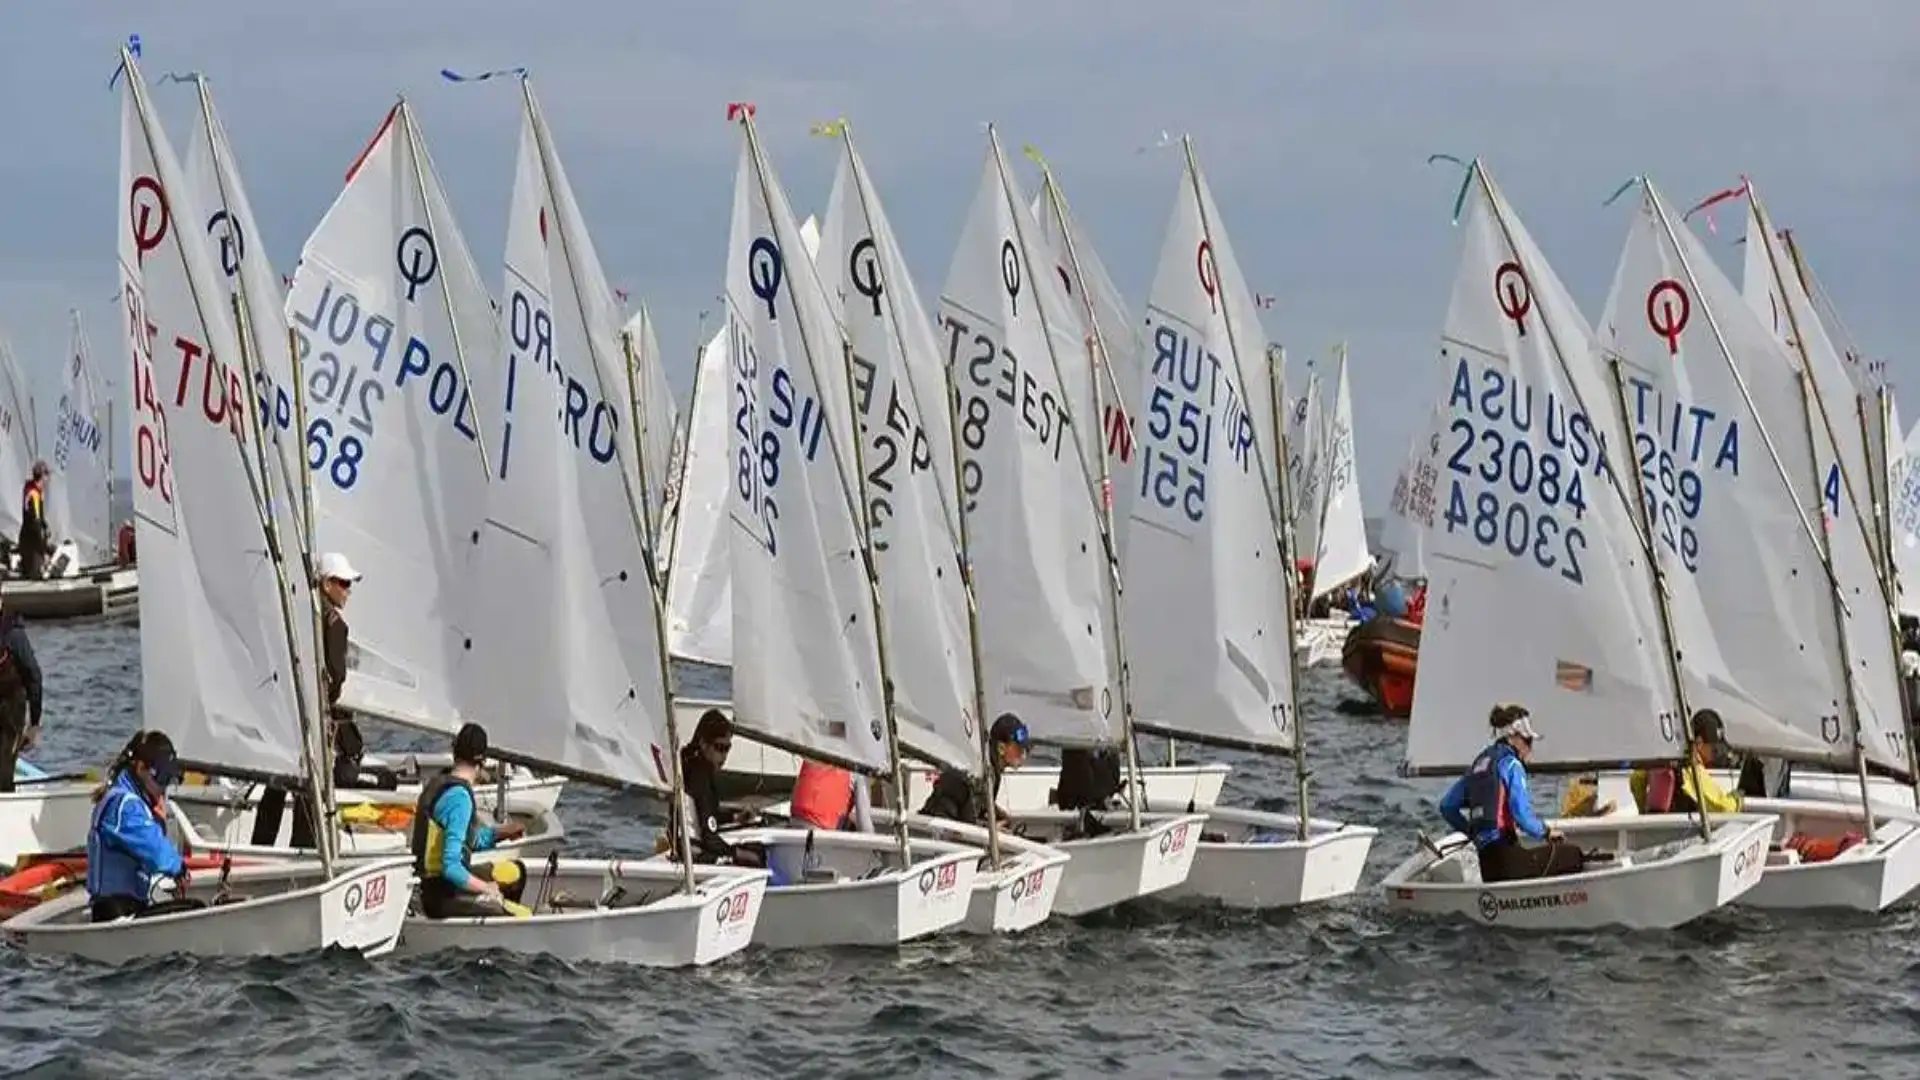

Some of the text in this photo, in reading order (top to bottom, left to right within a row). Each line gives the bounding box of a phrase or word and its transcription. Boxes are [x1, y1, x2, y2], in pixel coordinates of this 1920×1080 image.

[396, 336, 475, 441] POL
[557, 376, 618, 464] RO
[1149, 386, 1211, 463] 551
[1447, 418, 1587, 520] 23084
[1671, 401, 1739, 476] ITA
